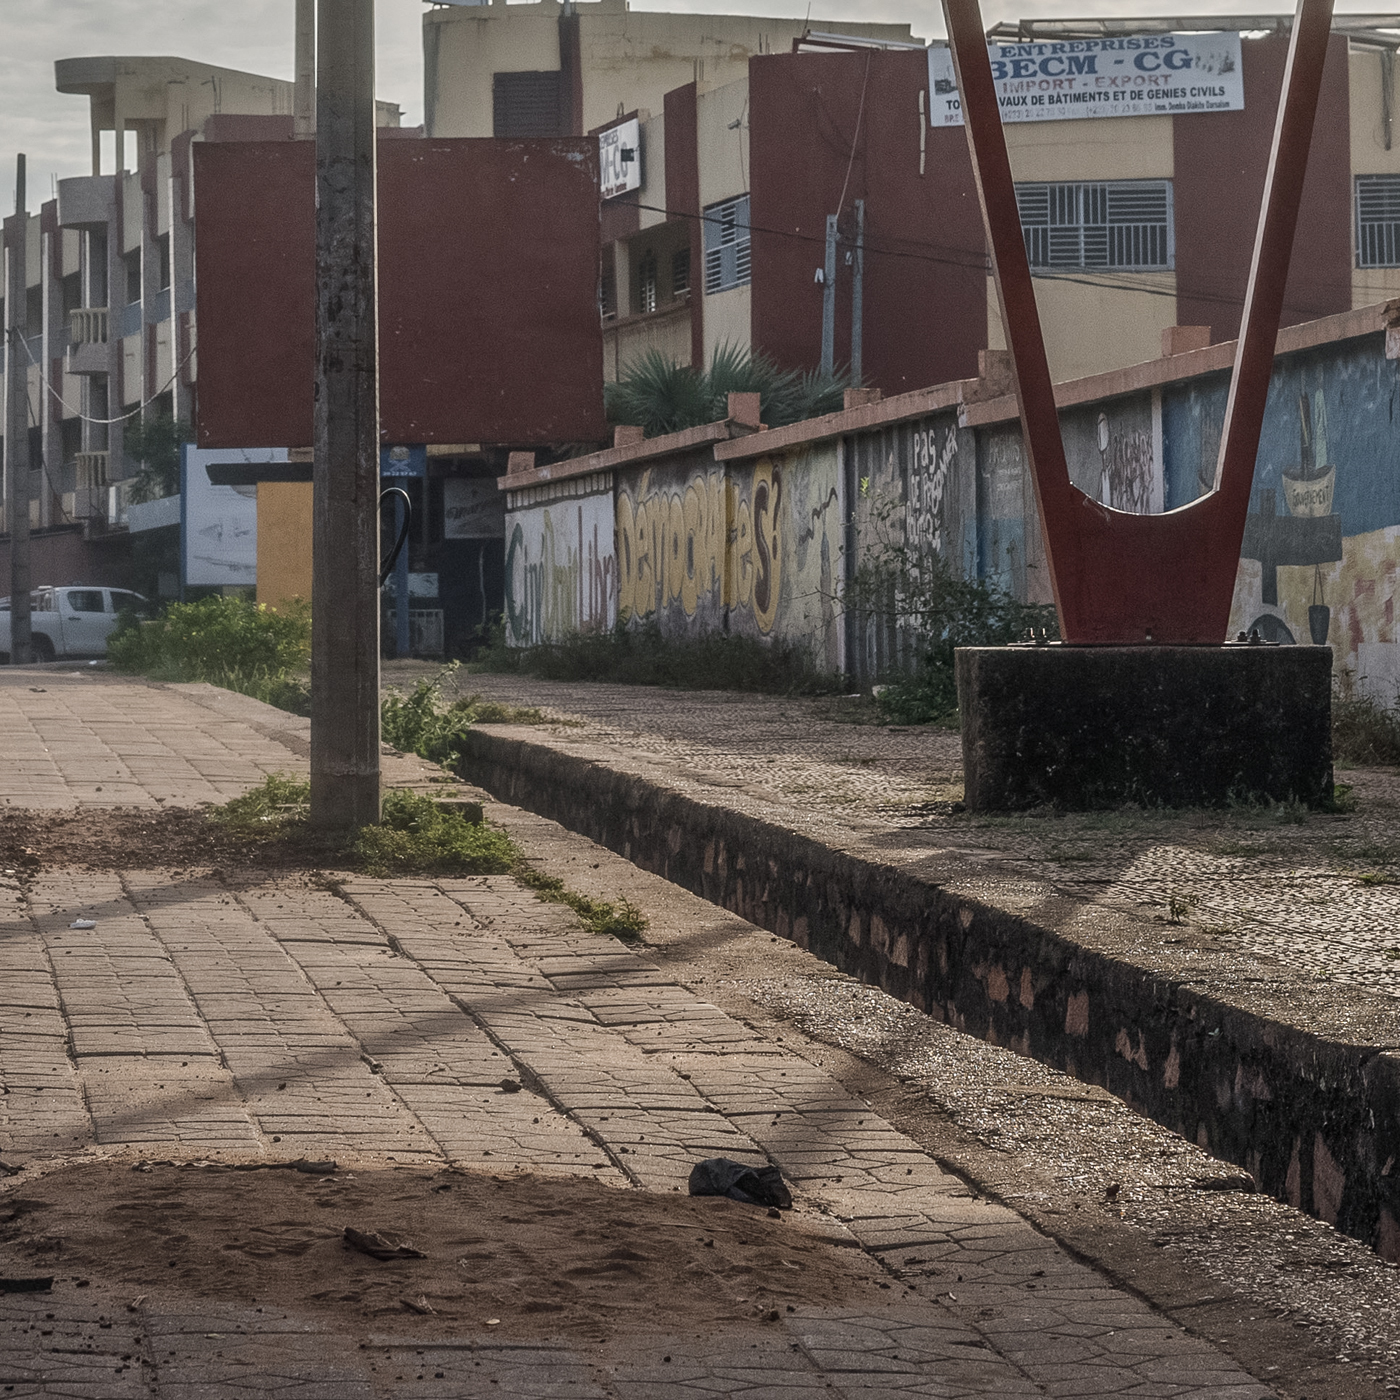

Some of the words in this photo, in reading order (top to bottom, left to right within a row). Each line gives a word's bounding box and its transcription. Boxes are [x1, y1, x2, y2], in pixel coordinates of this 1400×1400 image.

[1000, 36, 1176, 58] ENTREPRISES
[1133, 49, 1194, 72] CG
[1003, 78, 1076, 95] IMPORT
[1094, 74, 1173, 89] EXPORT
[1030, 93, 1045, 106] DE
[1048, 90, 1110, 105] BÂTIMENTS
[1113, 90, 1127, 102] ET
[1130, 89, 1144, 101] DE
[1146, 87, 1187, 100] GENIES
[1189, 85, 1226, 98] CIVILS
